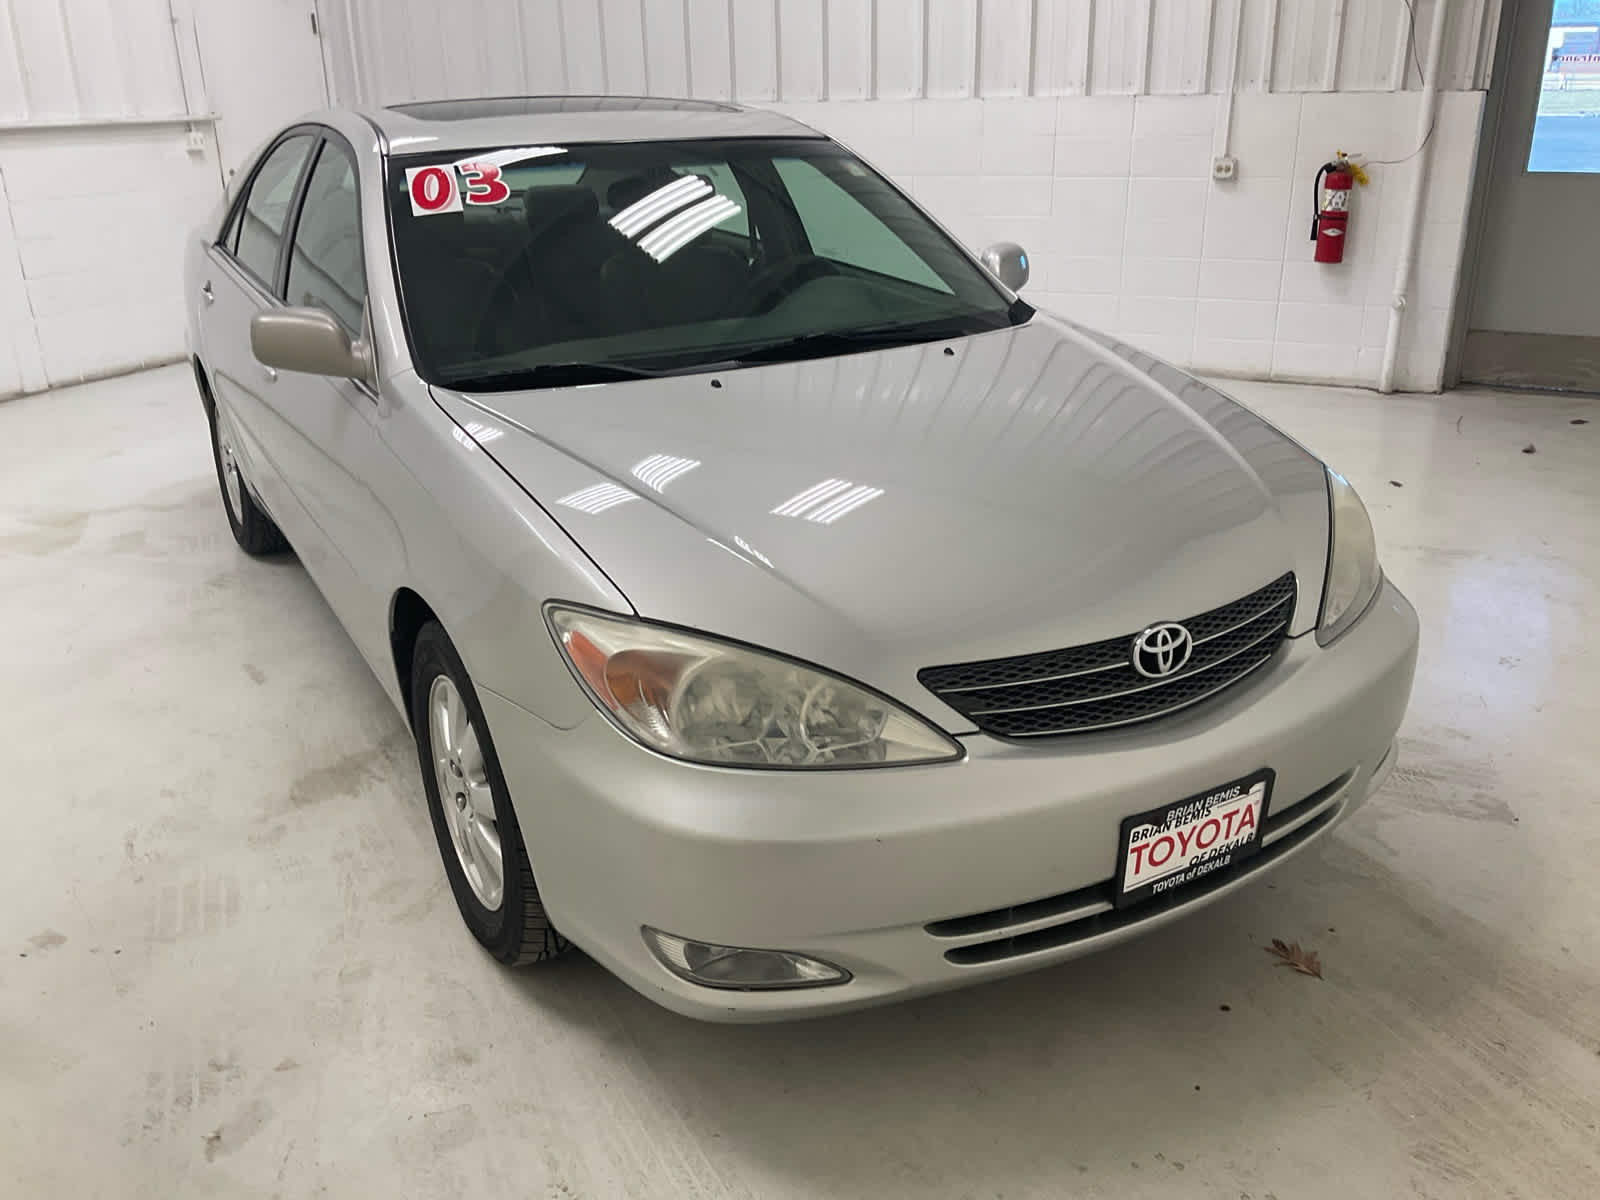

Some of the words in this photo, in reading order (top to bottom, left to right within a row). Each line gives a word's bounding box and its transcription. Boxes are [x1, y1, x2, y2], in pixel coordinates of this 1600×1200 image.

[411, 162, 511, 211] 03
[1166, 800, 1204, 822] BRIAN
[1205, 786, 1241, 808] BEMIS
[1130, 803, 1255, 875] TOYOTA
[1131, 821, 1172, 843] BRIAN
[1174, 808, 1212, 829] BEMIS
[1152, 872, 1185, 895] TOYOTA
[1186, 868, 1197, 881] of
[1197, 854, 1231, 876] DEKALB
